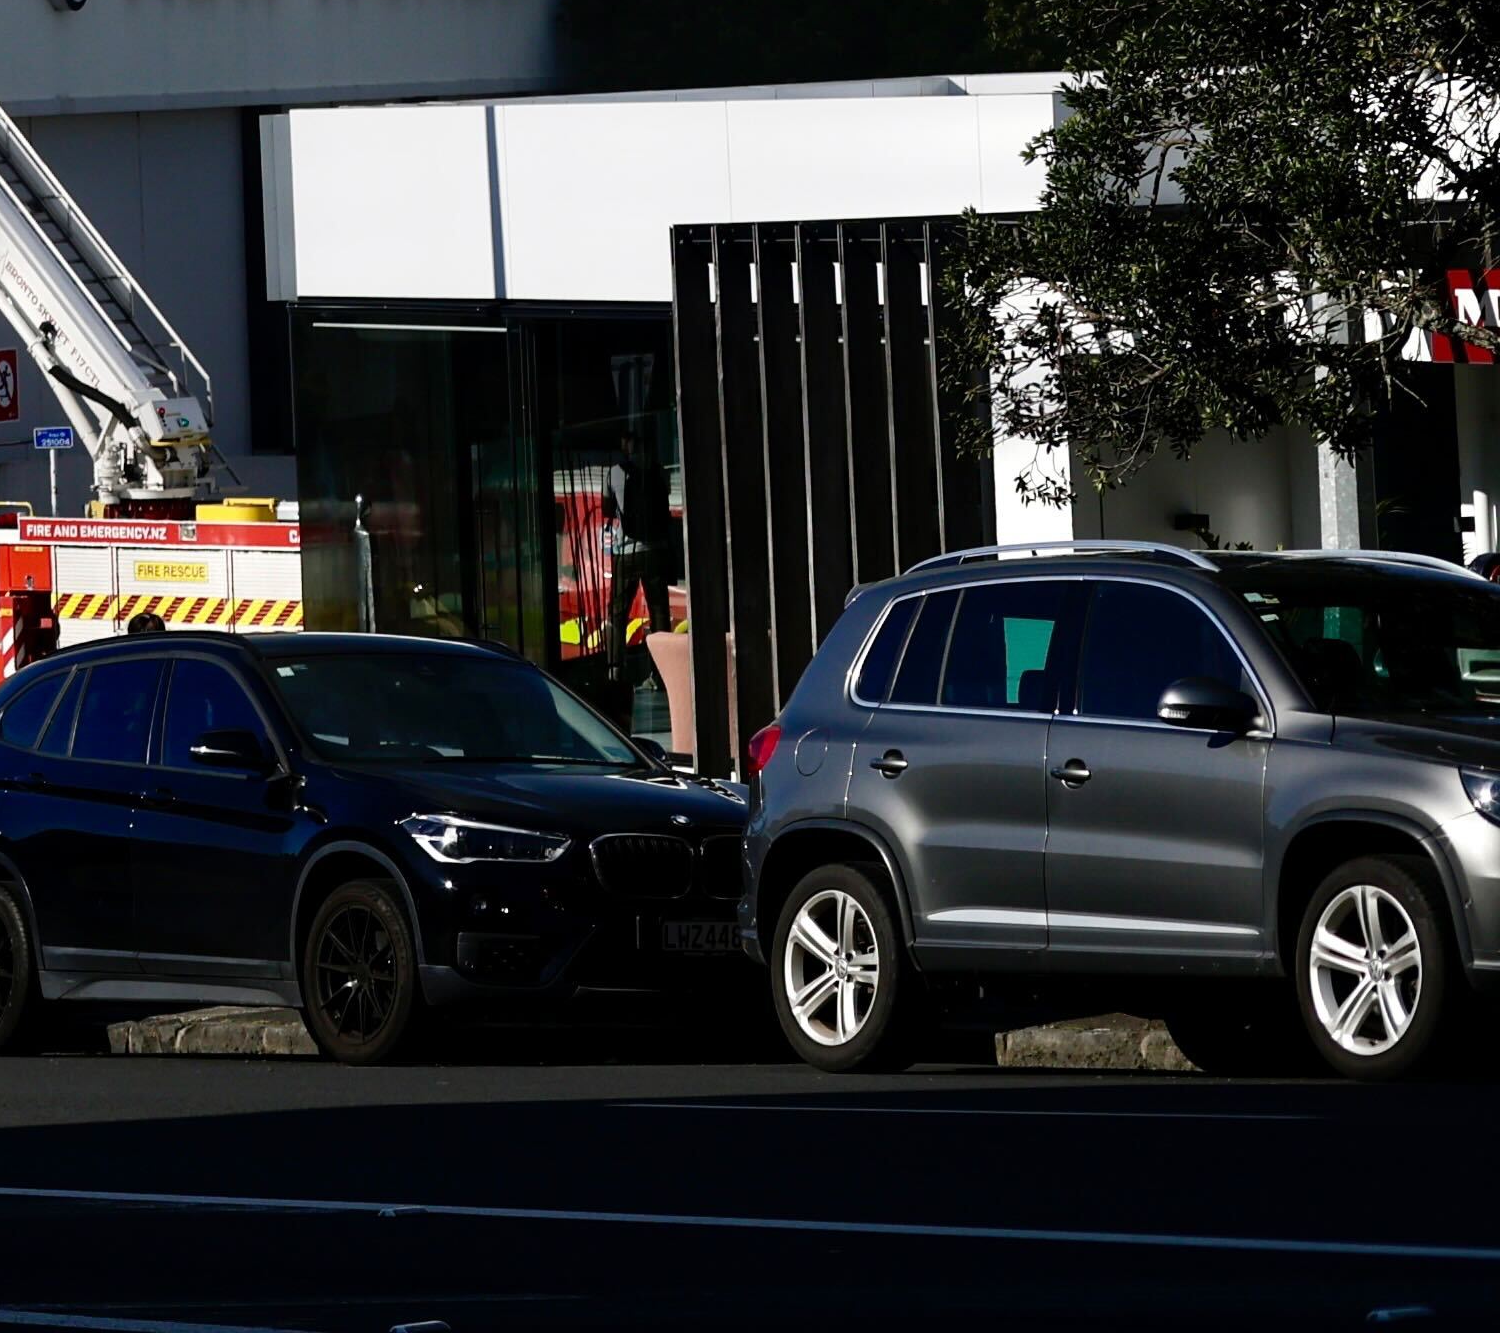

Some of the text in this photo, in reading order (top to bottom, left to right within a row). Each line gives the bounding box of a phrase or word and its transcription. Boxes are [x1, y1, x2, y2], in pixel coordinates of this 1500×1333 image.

[26, 524, 167, 541] FIRE AND EMERGENCY.NZ
[138, 565, 205, 579] FIRE RESCUE
